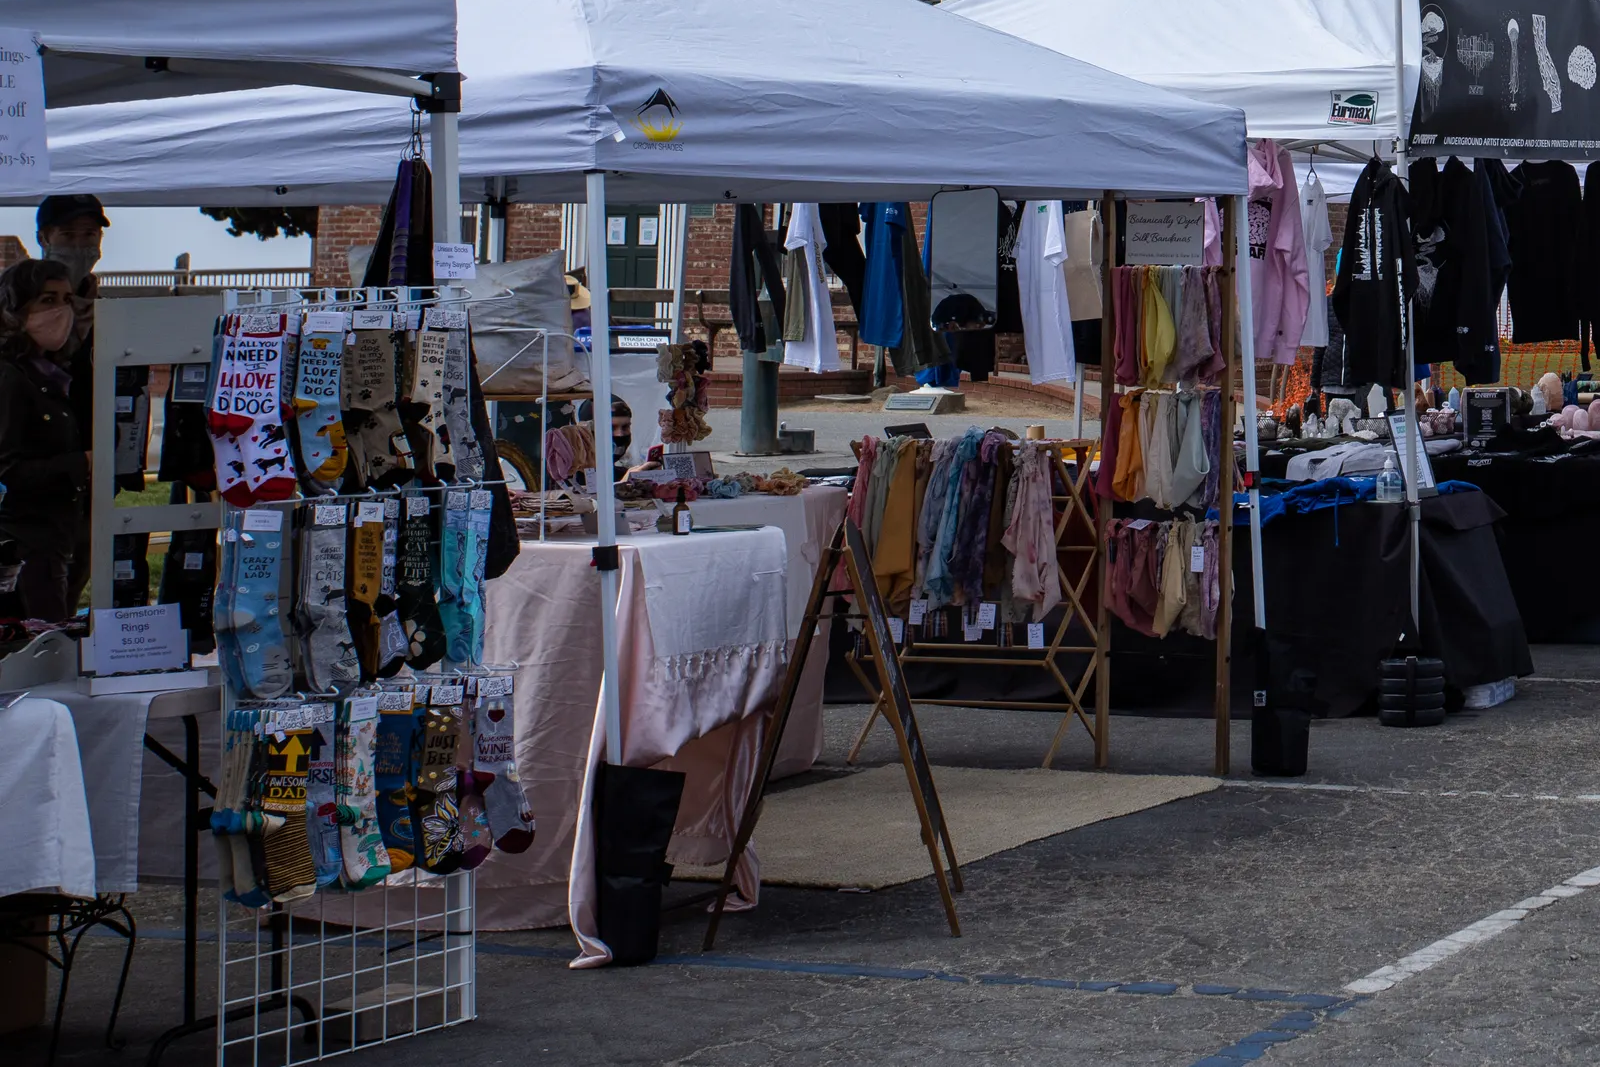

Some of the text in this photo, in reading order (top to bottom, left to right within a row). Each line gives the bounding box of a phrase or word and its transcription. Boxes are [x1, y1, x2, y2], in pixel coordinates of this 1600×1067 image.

[0, 47, 31, 65] ings~
[0, 74, 16, 89] LE
[8, 101, 27, 117] off
[1331, 102, 1372, 120] Eurmax
[633, 142, 684, 151] CROWN SHADES
[1443, 136, 1482, 146] UNDERGROUND
[1483, 137, 1500, 146] ARTIST
[1500, 138, 1524, 147] DESIGNED
[1525, 139, 1535, 147] AND
[1535, 139, 1551, 148] SCREEN
[1551, 139, 1569, 148] PRINTED
[1569, 140, 1578, 148] ART
[1578, 140, 1595, 148] INFUSED
[1128, 214, 1202, 229] Botanically Dyed
[1132, 232, 1192, 244] Silk Bandanas
[454, 246, 468, 254] Socks
[237, 349, 278, 362] NEED
[320, 350, 341, 359] YOU
[421, 356, 444, 364] DOG
[304, 366, 338, 378] LOVE
[235, 372, 276, 389] LOVE
[302, 377, 324, 386] AND
[304, 386, 335, 396] DOG
[234, 397, 275, 415] DOG
[242, 556, 275, 564] CRAZY
[316, 570, 343, 582] CATS
[115, 608, 166, 619] Gemstone
[121, 622, 150, 633] Rings
[121, 636, 145, 645] $5.00
[428, 734, 457, 749] JUST
[477, 733, 514, 743] Awesome
[478, 742, 511, 754] WINE
[425, 751, 453, 766] BEE
[270, 788, 307, 798] DAD
